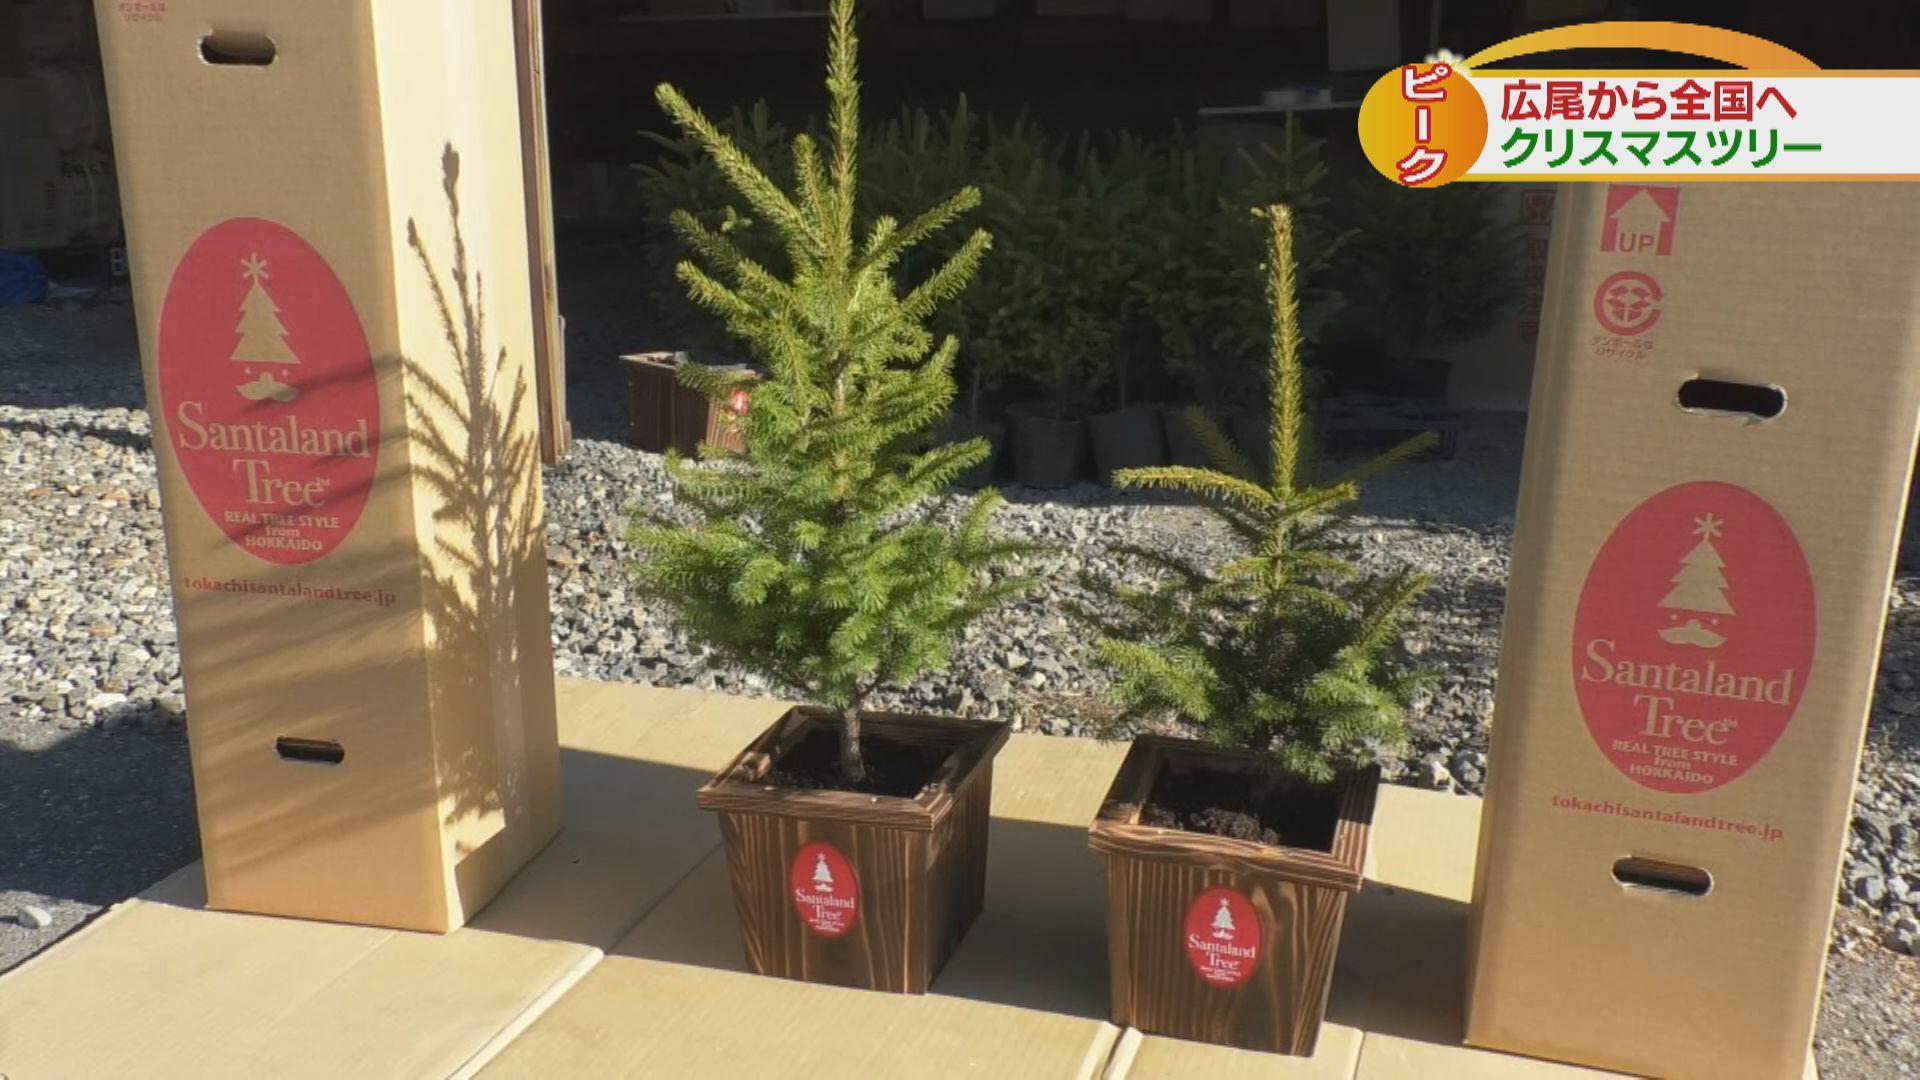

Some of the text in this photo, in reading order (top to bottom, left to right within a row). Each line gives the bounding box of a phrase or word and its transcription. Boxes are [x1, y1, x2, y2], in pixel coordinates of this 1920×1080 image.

[1618, 232, 1655, 254] UP
[177, 400, 372, 459] Santaland
[224, 510, 260, 525] REAL
[298, 514, 341, 529] STYLE
[264, 526, 301, 538] from
[244, 536, 324, 551] HOKKAIDO
[183, 576, 397, 606] tokachisantalandtree.jp
[1580, 638, 1796, 706] Santaland
[1611, 739, 1740, 768] REAL TREE STYLE
[1654, 756, 1692, 770] from
[1629, 763, 1715, 785] HOKKAIDO
[1551, 795, 1784, 842] tokachisantalandtree.jp
[795, 887, 856, 909] Santaland
[1188, 932, 1256, 959] Santaland
